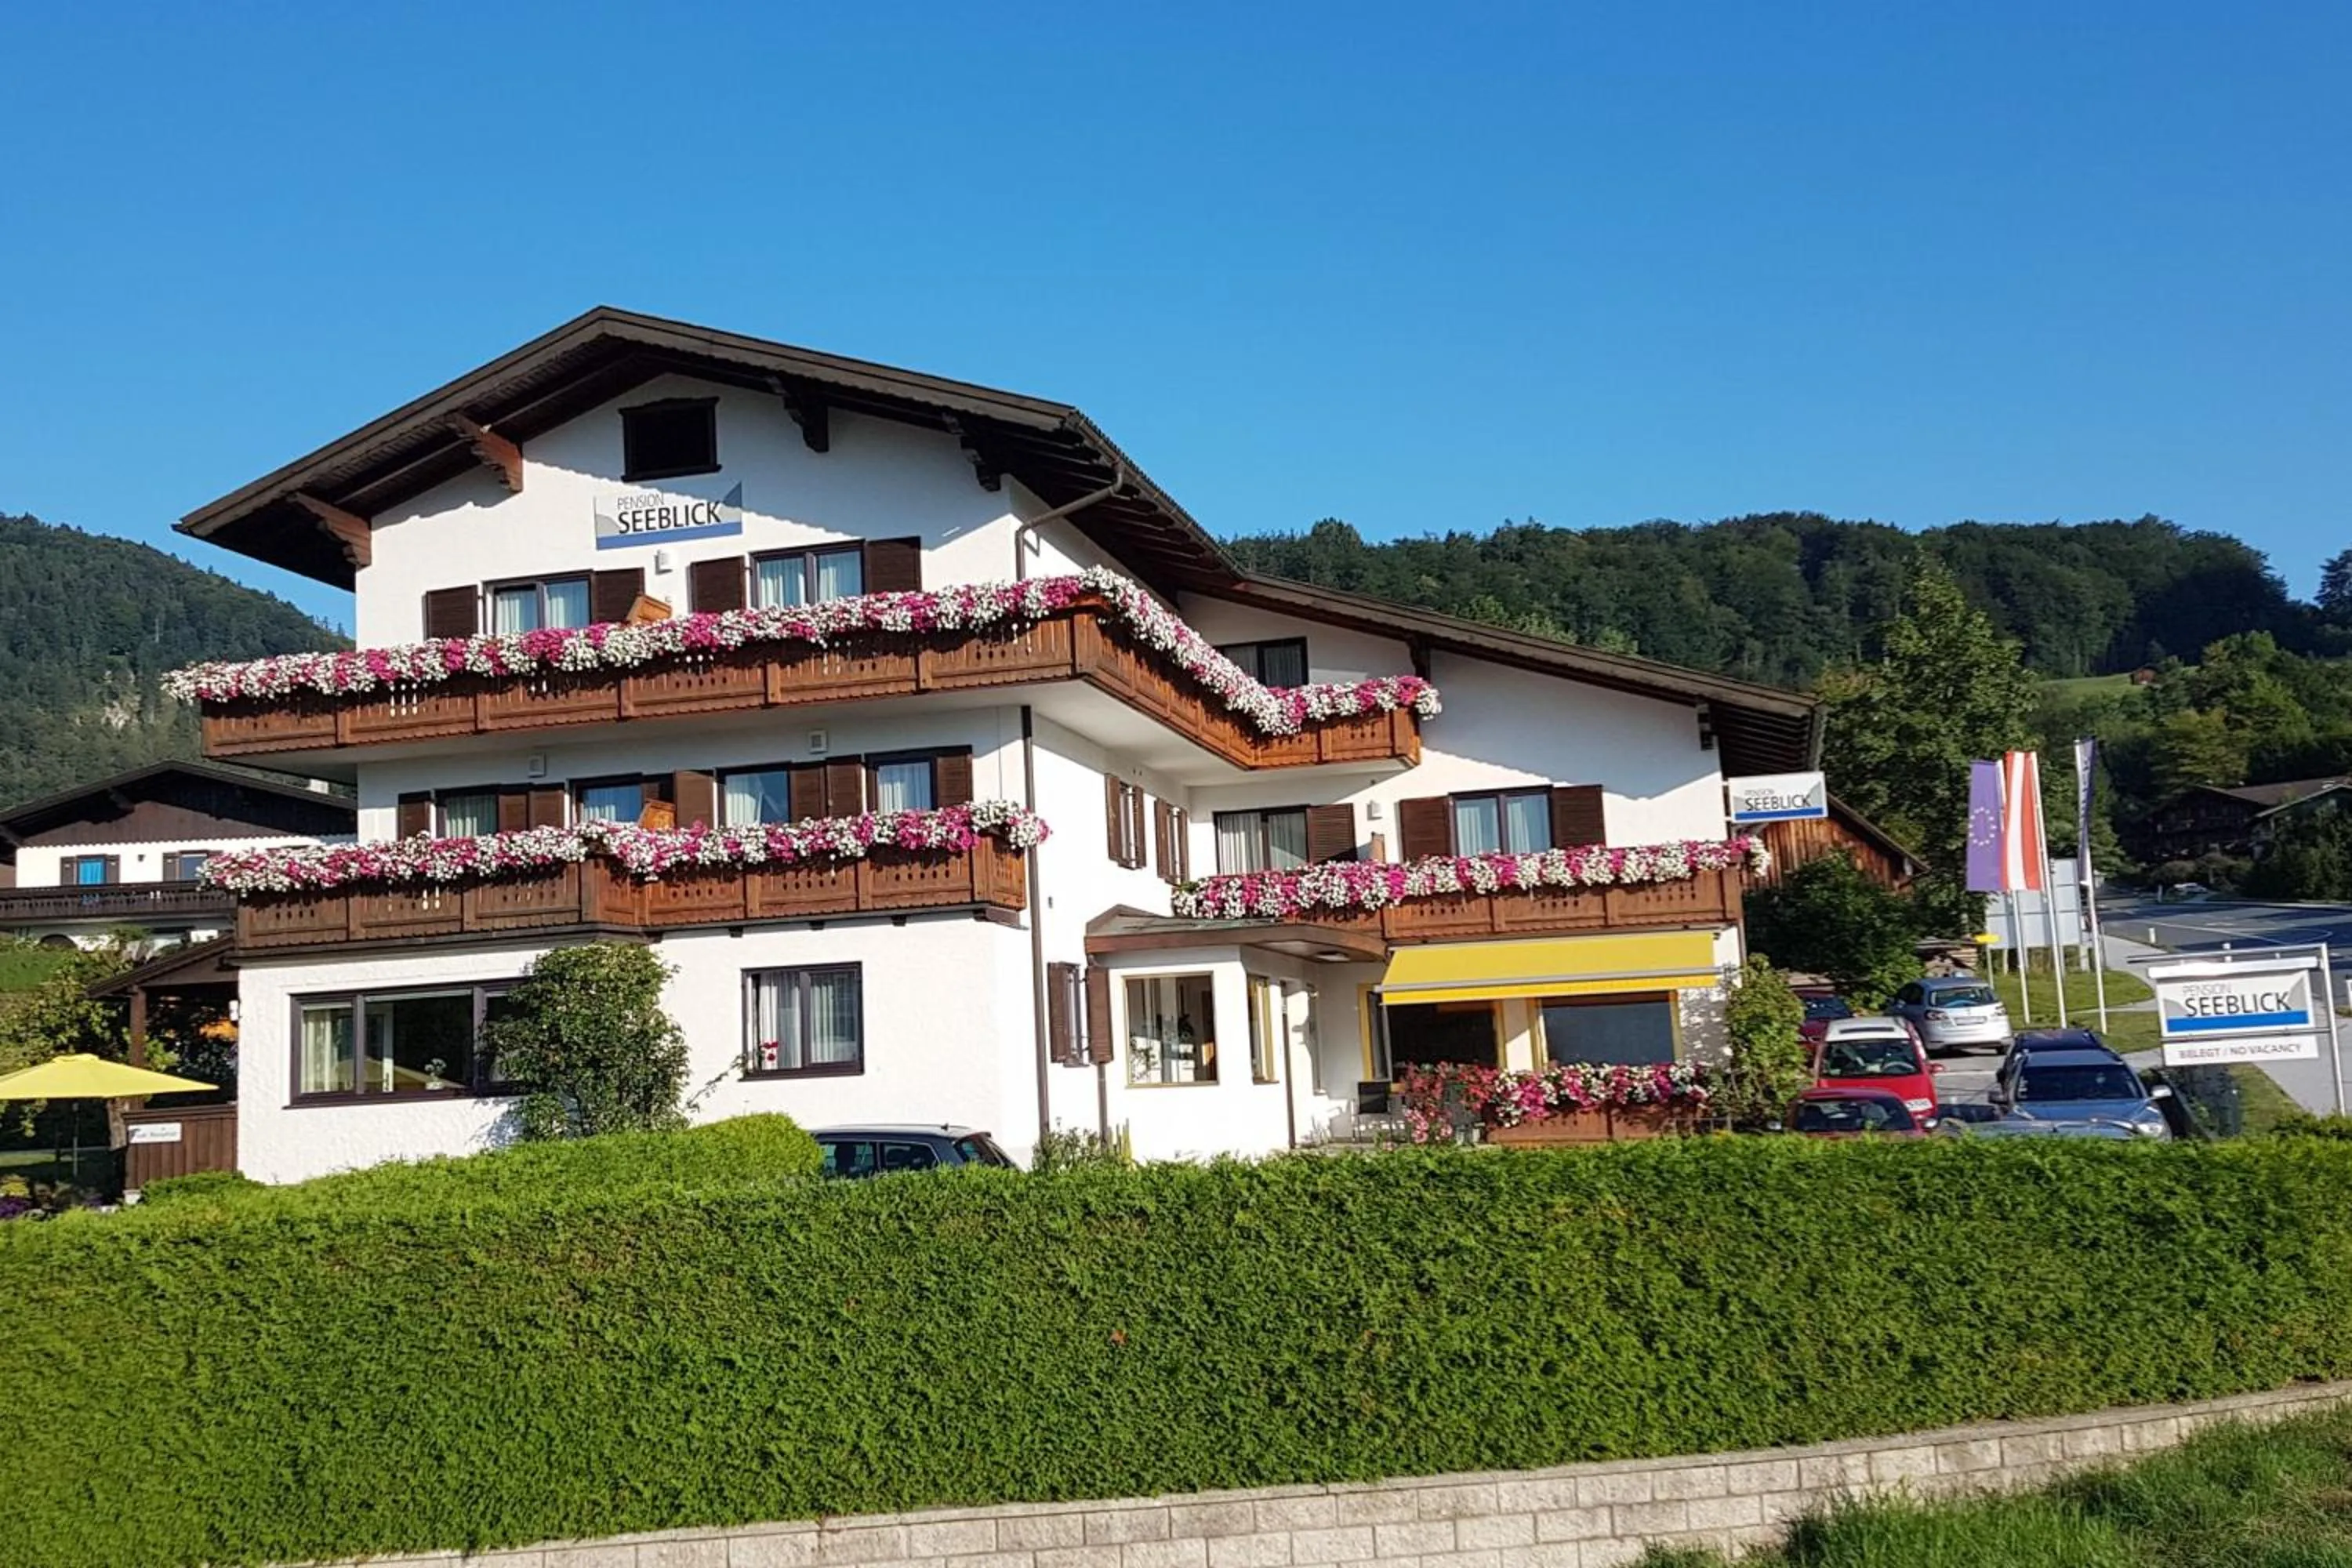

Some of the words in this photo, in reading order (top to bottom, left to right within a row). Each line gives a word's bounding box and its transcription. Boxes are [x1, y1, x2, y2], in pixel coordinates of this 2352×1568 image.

[617, 493, 665, 510] PENSION
[618, 500, 722, 535] SEEBLICK
[1744, 793, 1812, 811] SEEBLICK
[2184, 992, 2293, 1018] SEEBLICK
[2249, 1044, 2302, 1054] VACANCY
